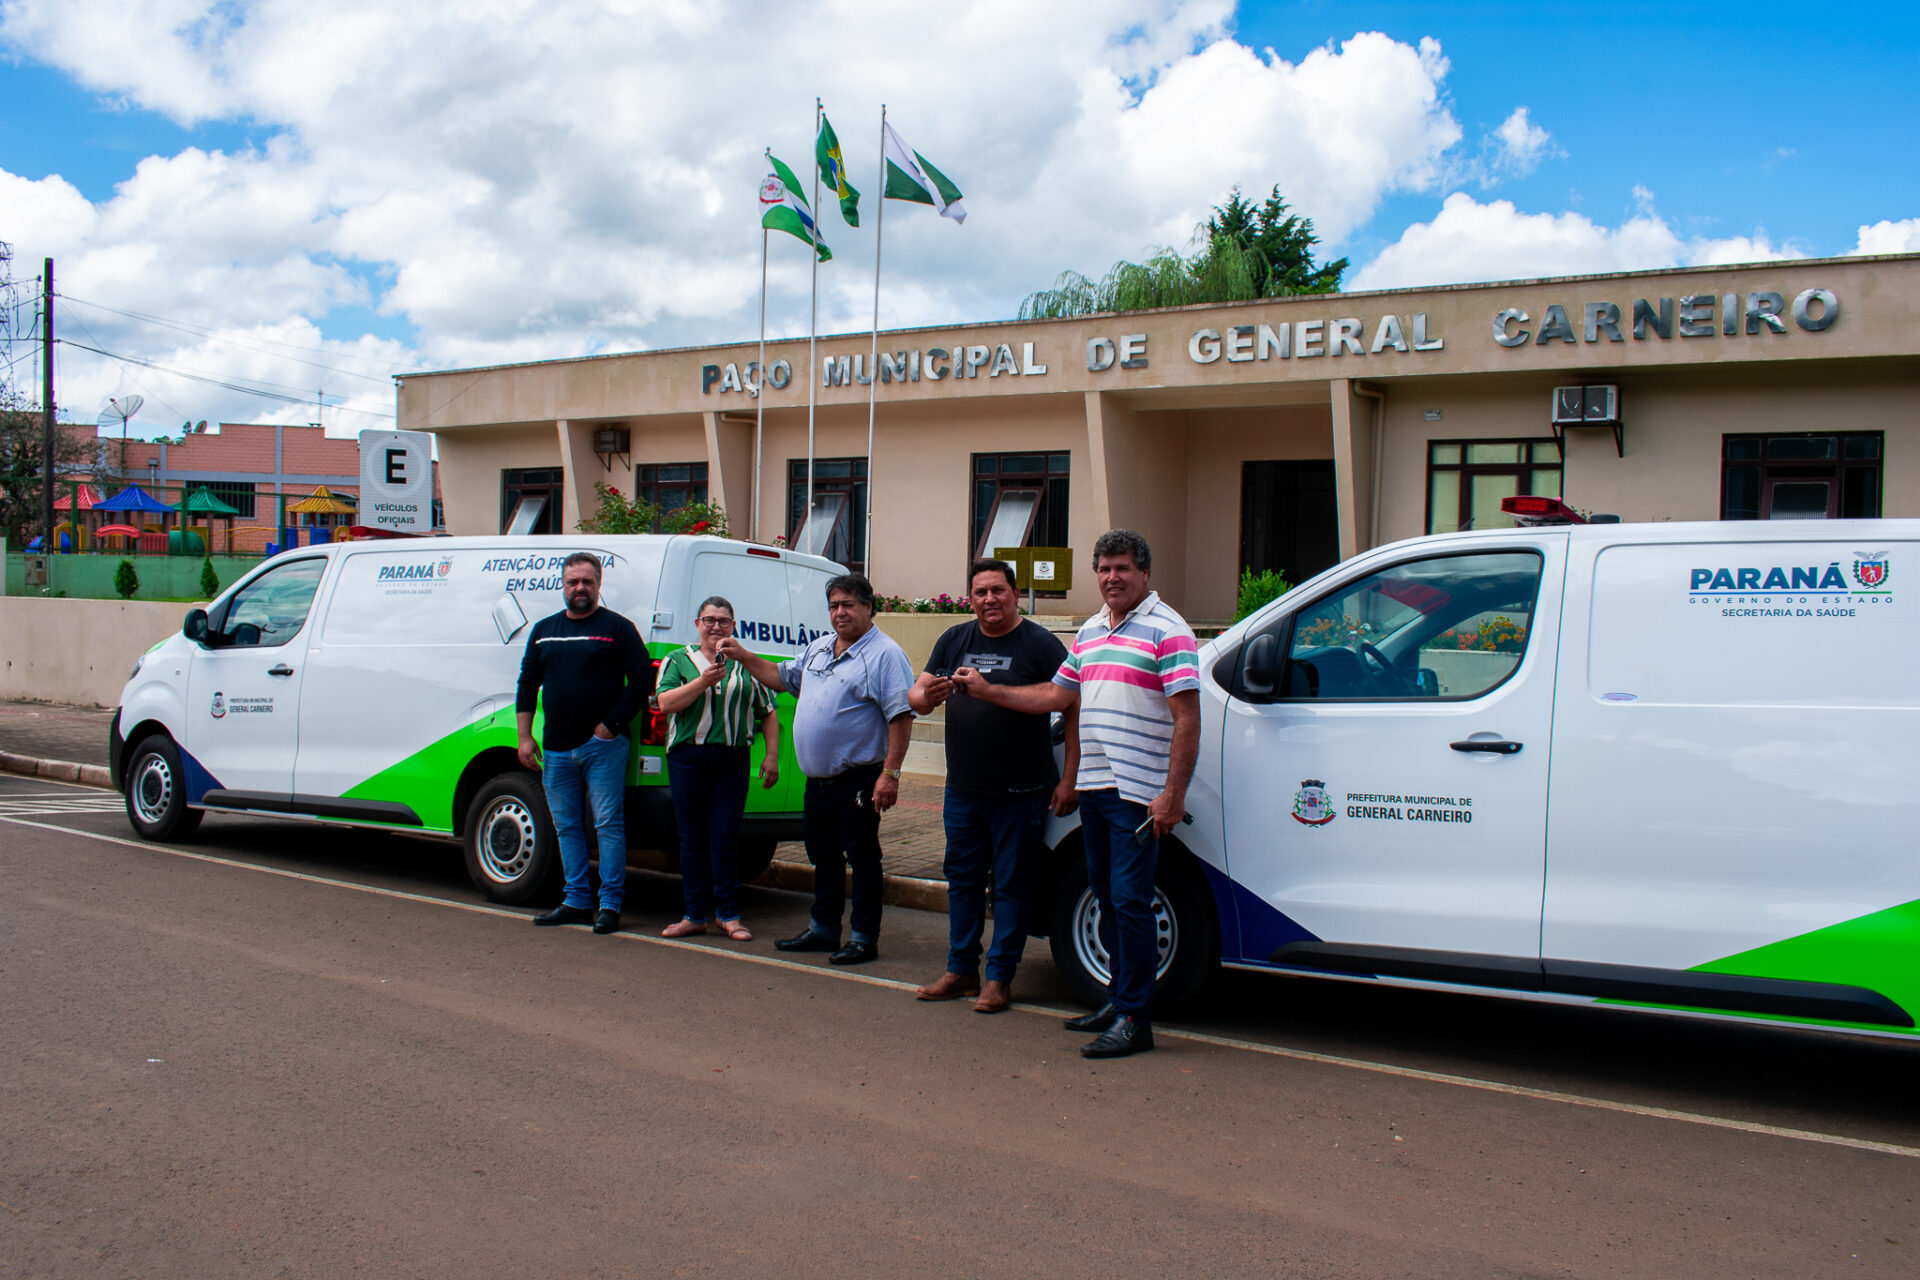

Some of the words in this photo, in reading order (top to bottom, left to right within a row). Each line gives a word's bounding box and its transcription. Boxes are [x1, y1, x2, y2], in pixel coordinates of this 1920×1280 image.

[702, 359, 793, 398] PAÇO
[823, 342, 1046, 387] MUNICIPAL
[1086, 334, 1148, 371] DE
[1188, 312, 1444, 364] GENERAL
[1492, 288, 1839, 347] CARNEIRO
[385, 448, 407, 485] E
[374, 503, 418, 512] VEÍCULOS
[377, 516, 415, 524] OFICIAIS
[378, 562, 435, 579] PARANÁ
[482, 554, 546, 573] ATENÇÃO
[506, 578, 525, 591] EM
[528, 575, 564, 591] SAÚD
[1690, 562, 1848, 590] PARANÁ
[1722, 608, 1793, 617] SECRETARIA
[1796, 609, 1812, 617] DA
[1816, 607, 1856, 617] SAÚDE
[1347, 793, 1401, 803] PREFEITURA
[1405, 796, 1457, 806] MUNICIPAL
[1459, 798, 1472, 806] DE
[1347, 805, 1403, 820] GENERAL
[1407, 808, 1472, 823] CARNEIRO
